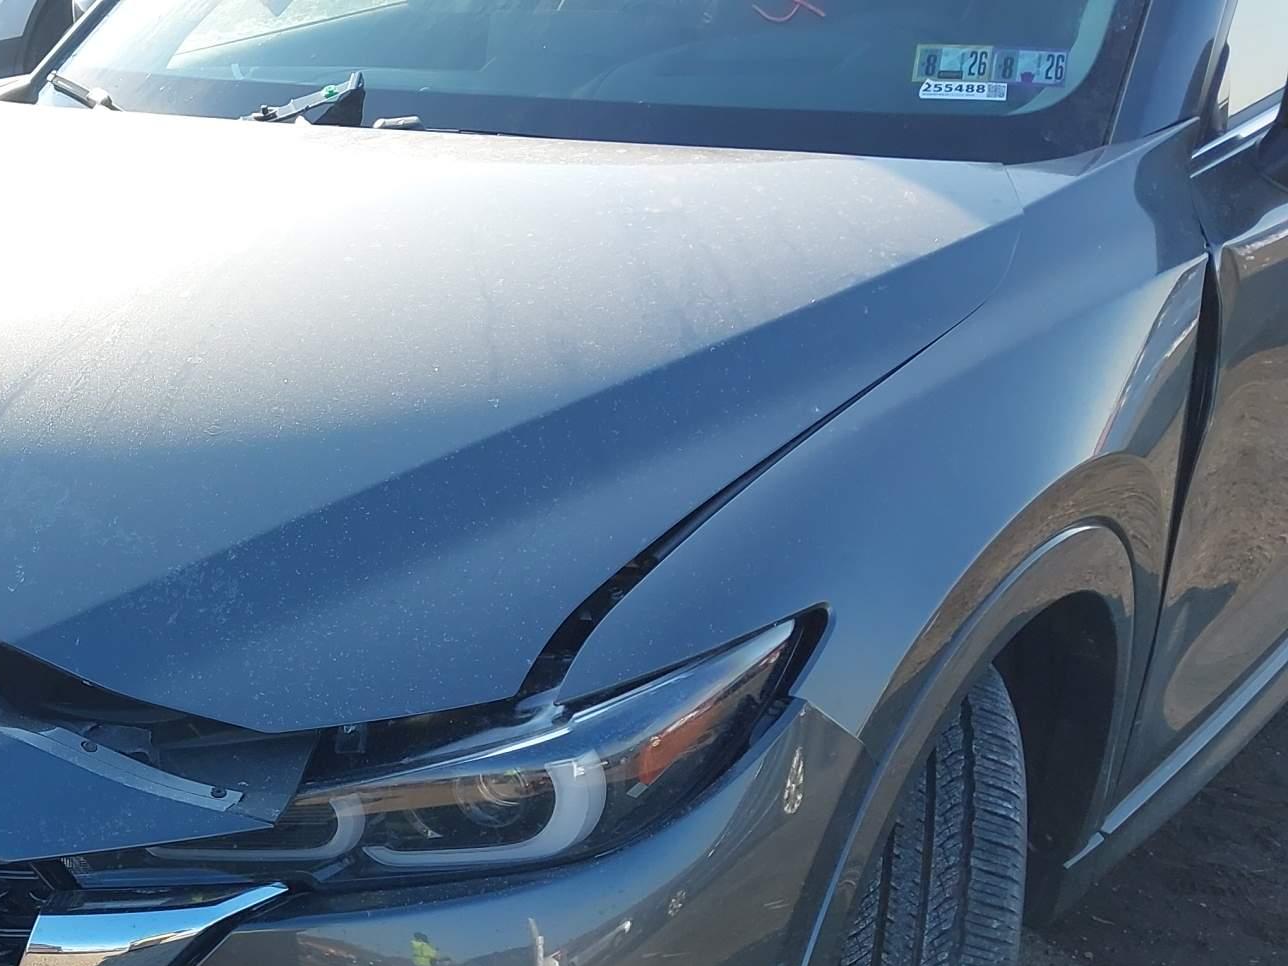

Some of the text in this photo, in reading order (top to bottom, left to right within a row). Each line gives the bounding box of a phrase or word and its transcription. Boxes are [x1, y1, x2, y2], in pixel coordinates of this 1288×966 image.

[925, 50, 988, 76] 8 26
[1002, 54, 1065, 80] 8 26
[922, 82, 986, 93] 255488
